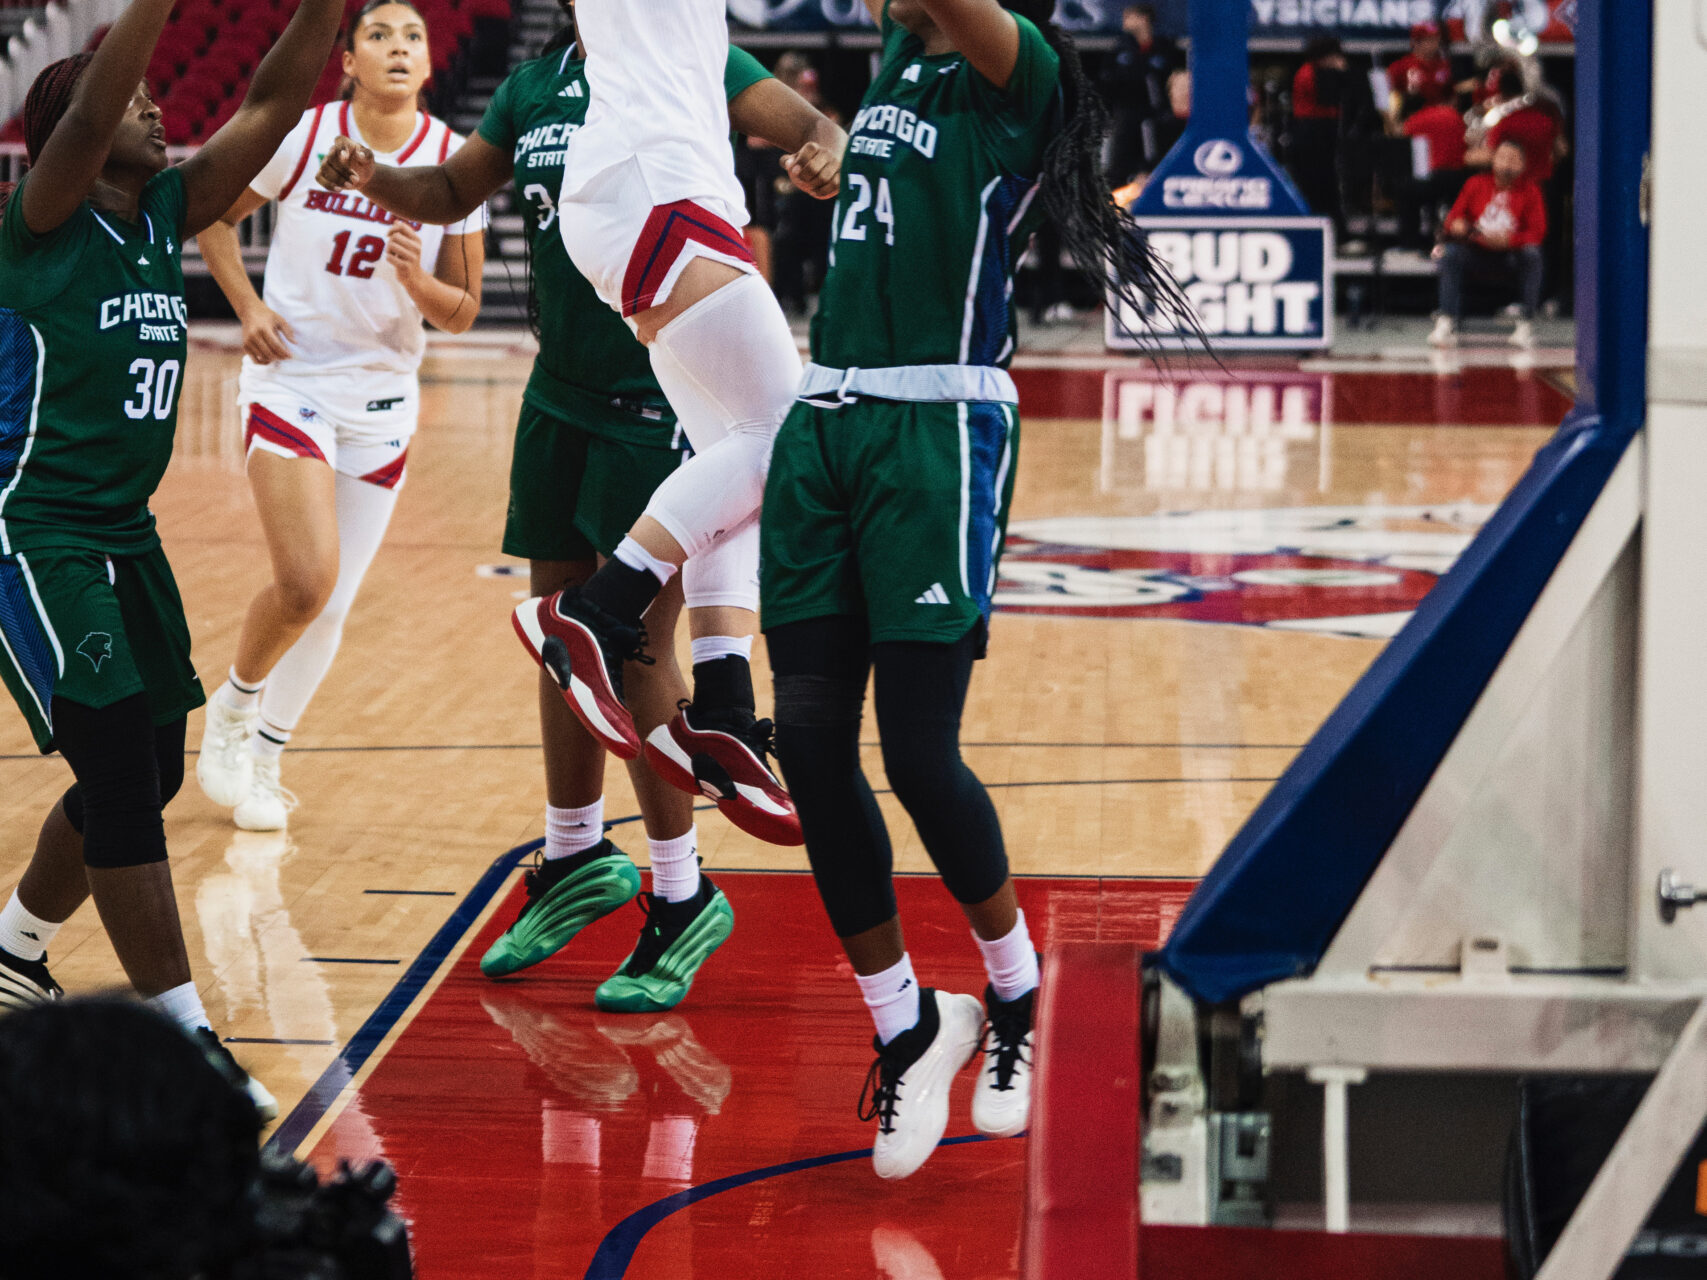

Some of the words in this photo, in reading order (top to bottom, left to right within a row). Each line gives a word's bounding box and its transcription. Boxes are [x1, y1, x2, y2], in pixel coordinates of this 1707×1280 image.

[513, 123, 582, 165] CHICA
[523, 183, 559, 231] 3
[840, 173, 895, 246] 24
[325, 230, 386, 280] 12
[1147, 231, 1294, 285] BUD
[99, 293, 188, 331] CHCAG
[139, 323, 180, 342] STATE
[123, 357, 180, 420] 30
